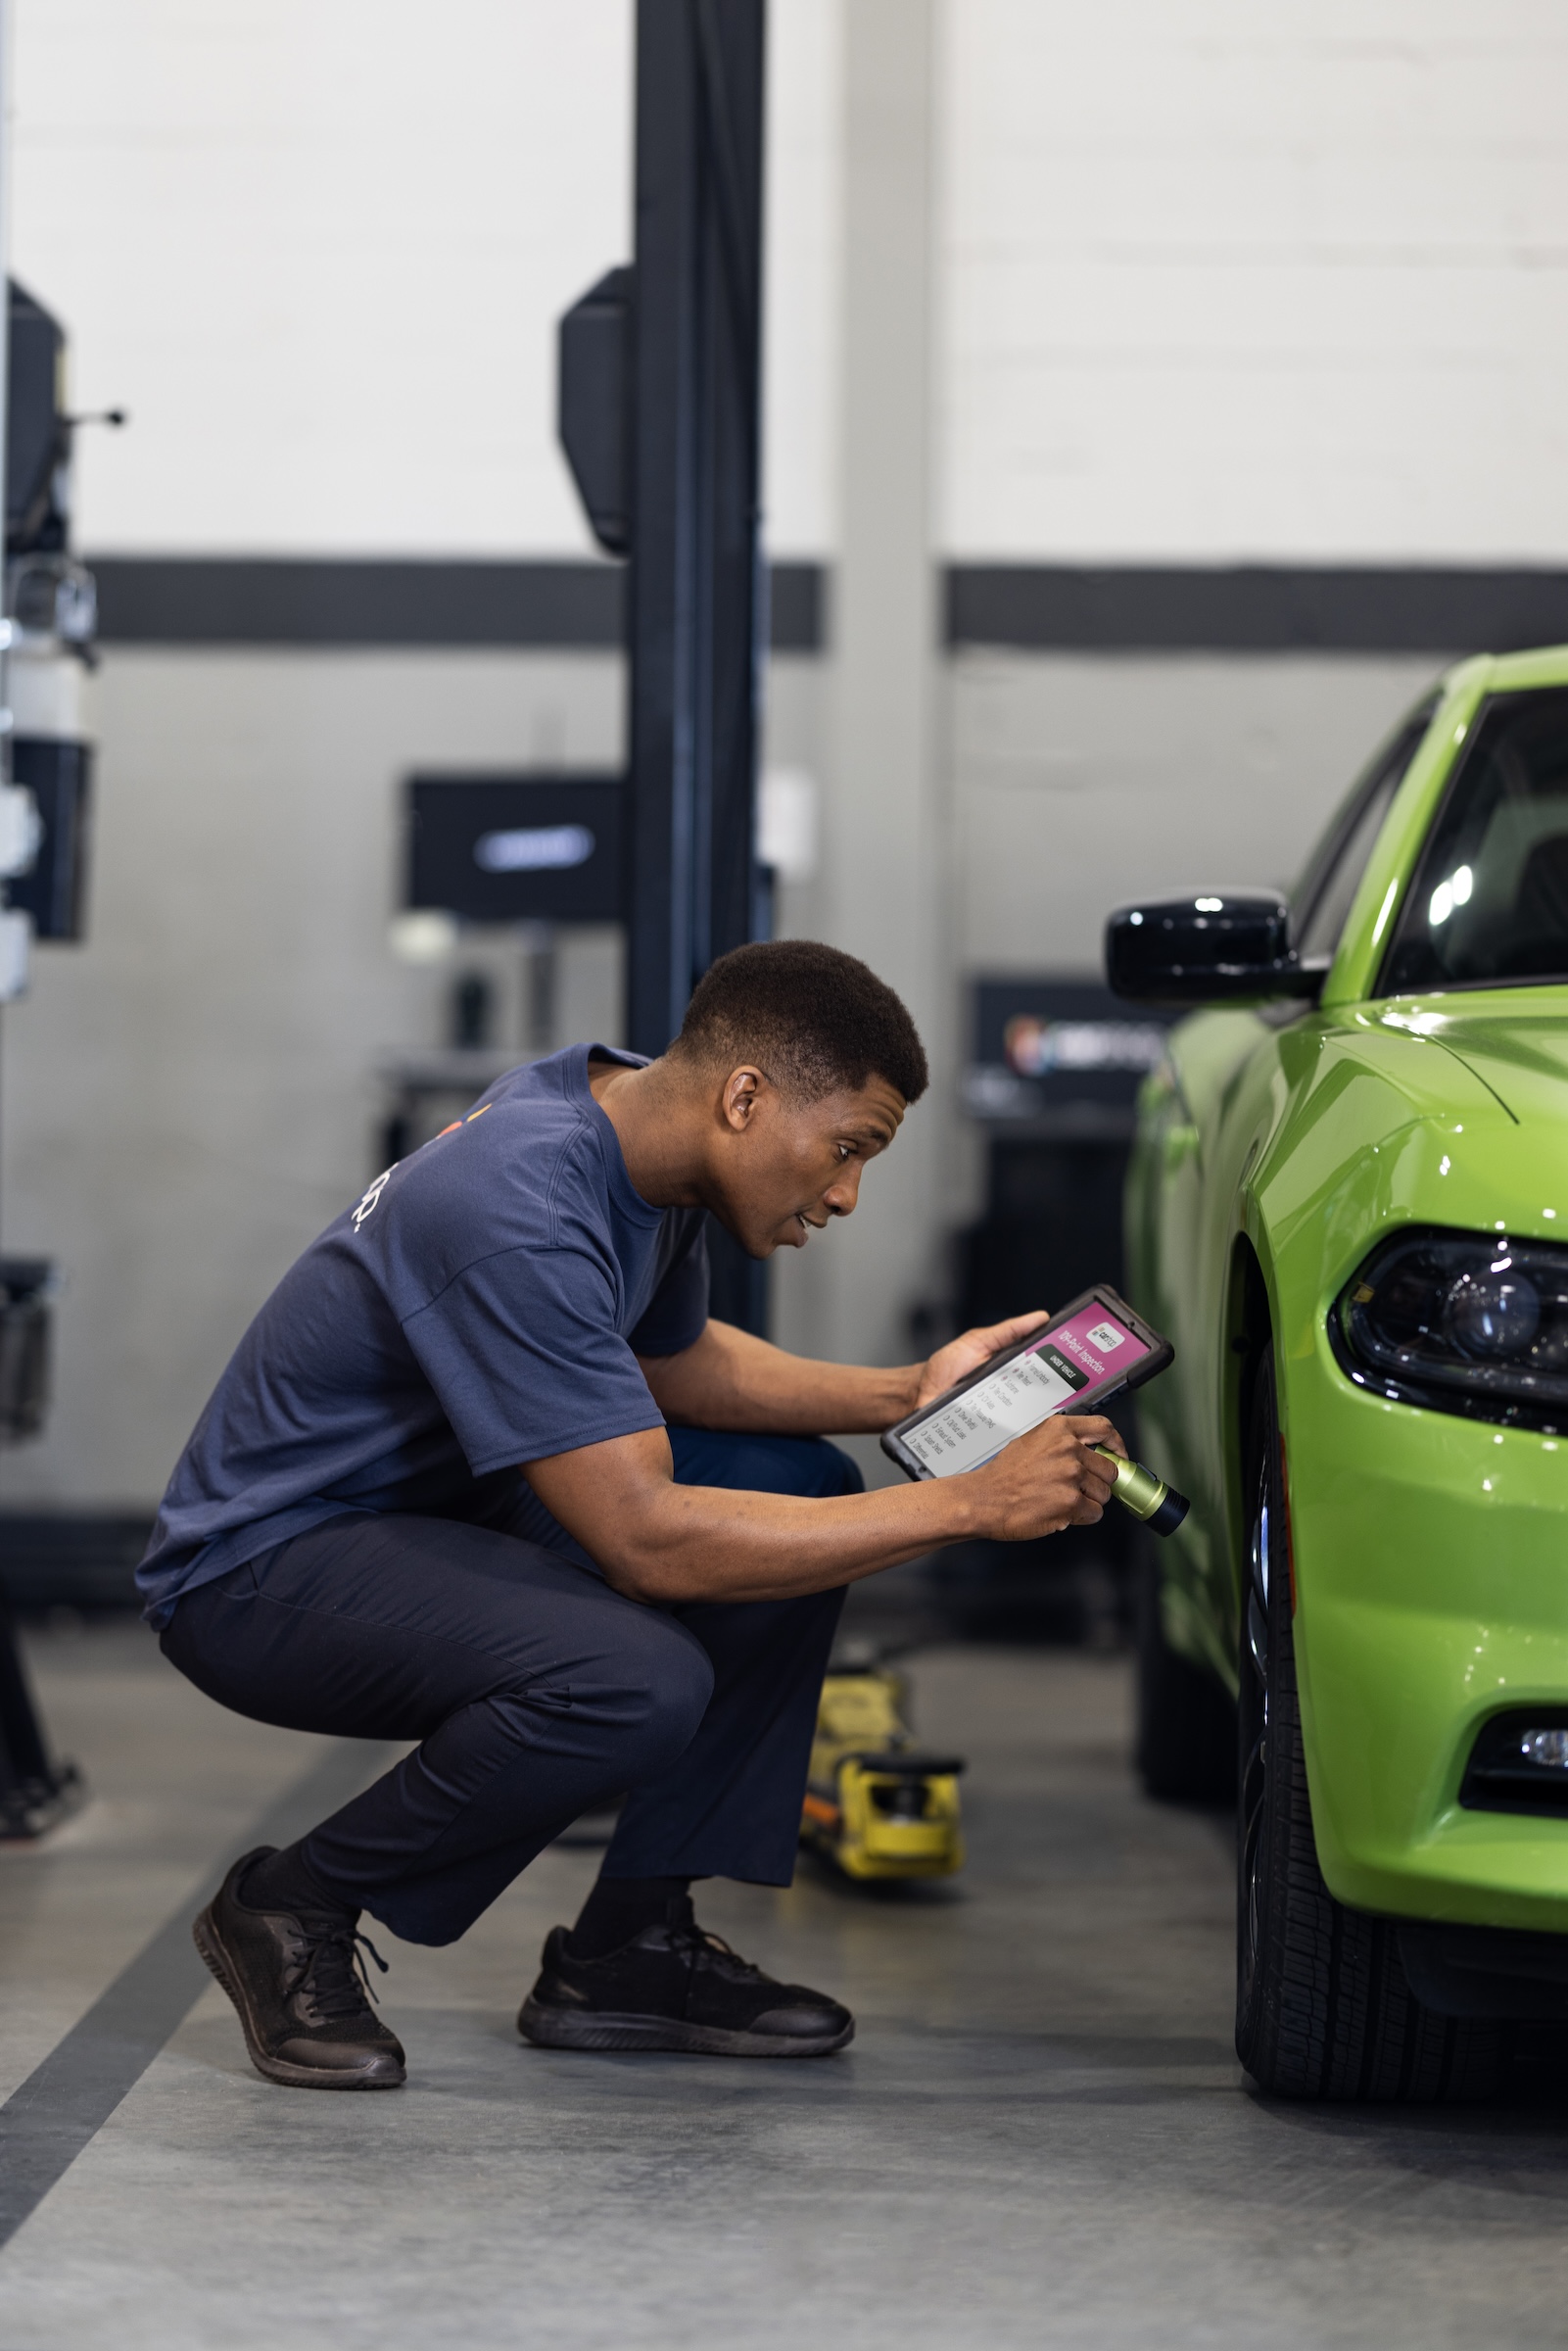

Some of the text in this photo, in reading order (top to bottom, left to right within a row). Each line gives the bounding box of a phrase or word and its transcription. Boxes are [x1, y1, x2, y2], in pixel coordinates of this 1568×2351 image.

[1058, 1330, 1084, 1353] 109-Point
[1049, 1354, 1075, 1378] UNDER VEHICLE
